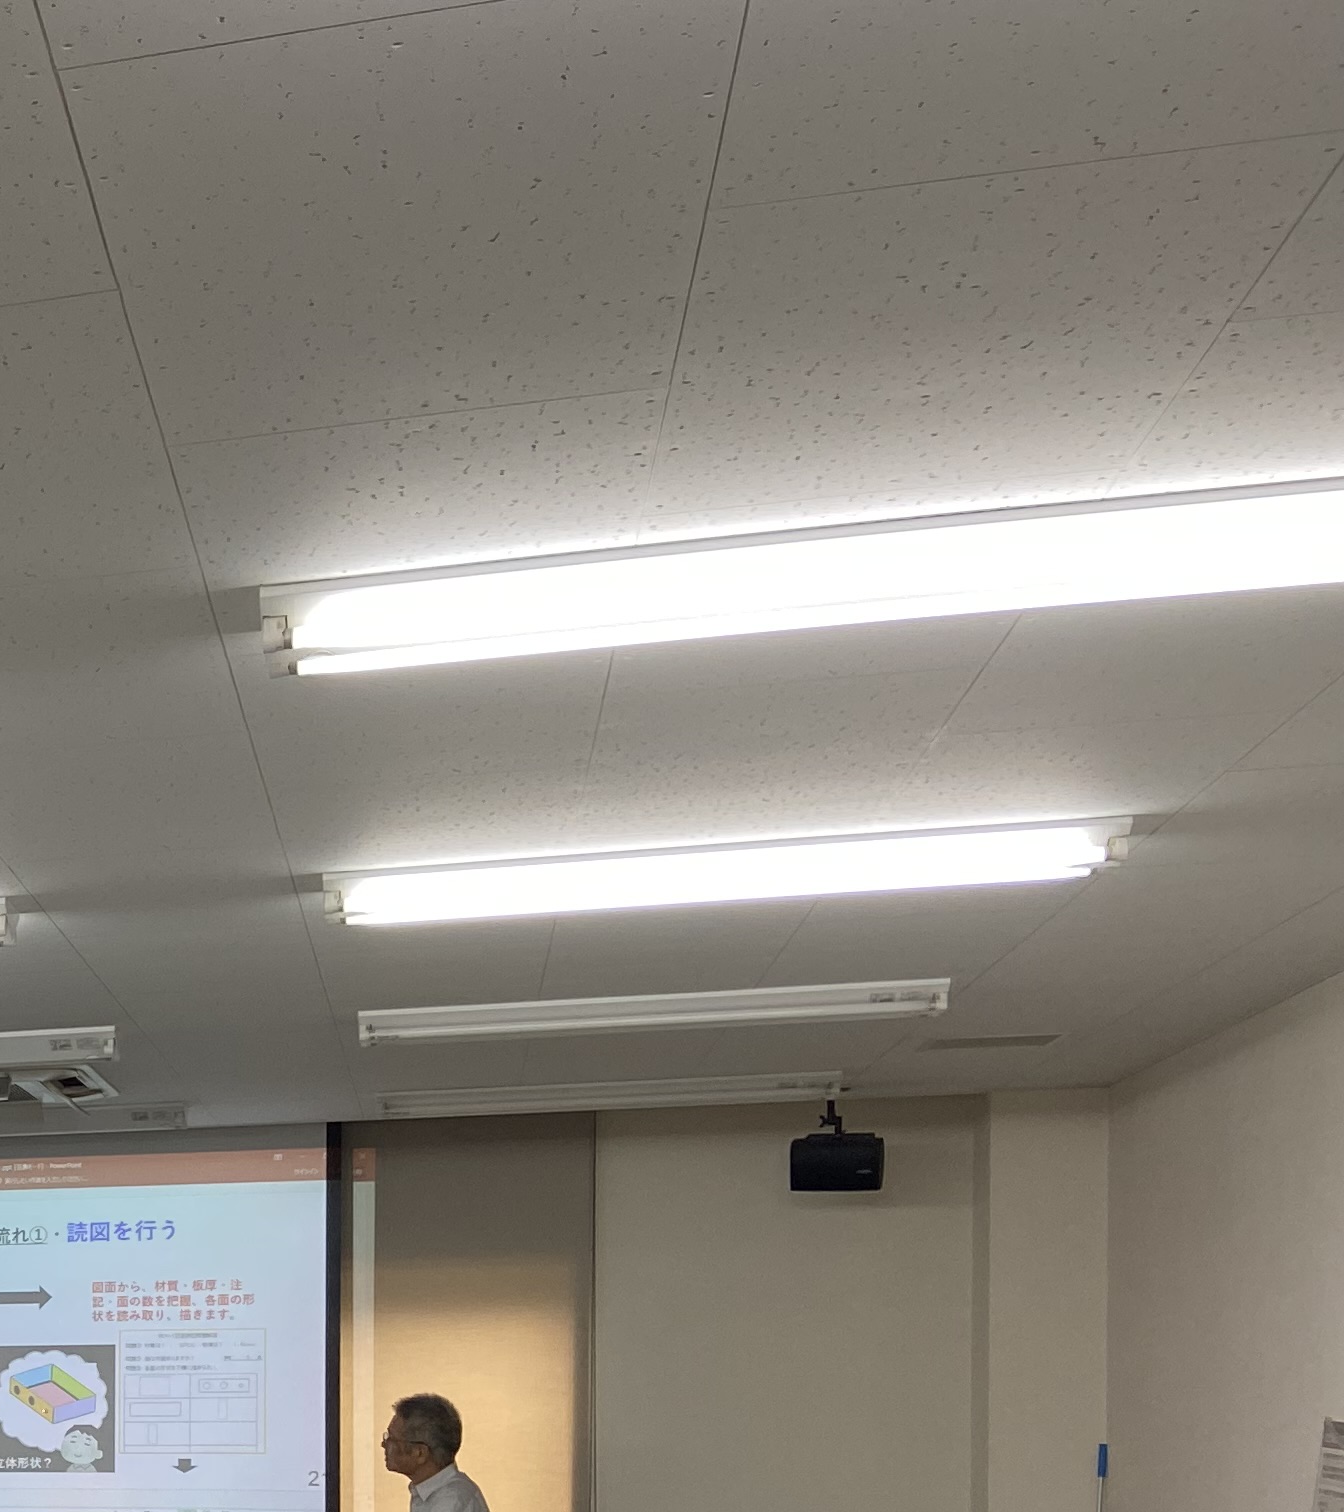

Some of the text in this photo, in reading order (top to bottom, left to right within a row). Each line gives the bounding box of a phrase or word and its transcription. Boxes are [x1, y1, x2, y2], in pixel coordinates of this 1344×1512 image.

[91, 1308, 235, 1322] 状を読み取り、描きます。
